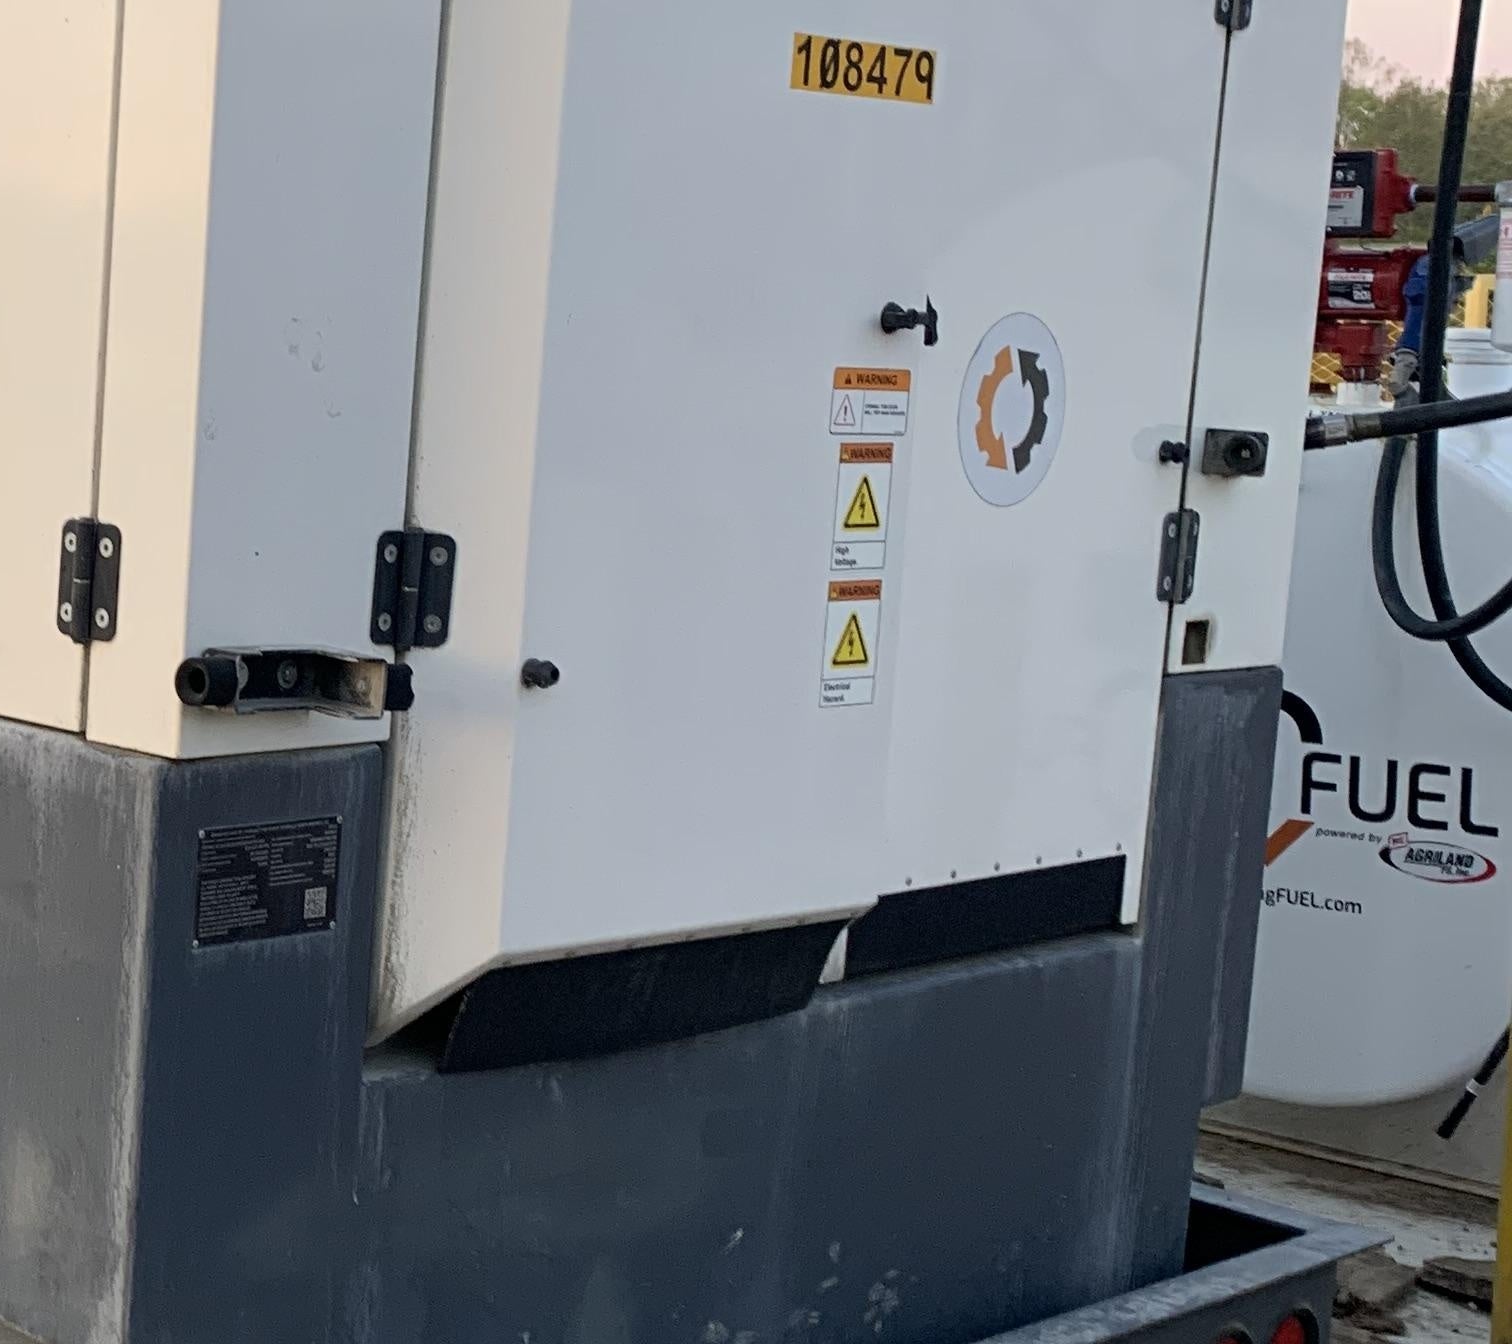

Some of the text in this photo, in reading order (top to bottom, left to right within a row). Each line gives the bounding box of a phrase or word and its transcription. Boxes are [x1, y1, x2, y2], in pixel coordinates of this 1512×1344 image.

[797, 35, 934, 100] 108479
[856, 373, 898, 386] WARNING
[850, 447, 892, 460] WARNING
[838, 585, 880, 596] WARNING
[1300, 751, 1499, 838] FUEL
[1315, 826, 1383, 844] powered by
[1404, 847, 1475, 869] AGRILAND
